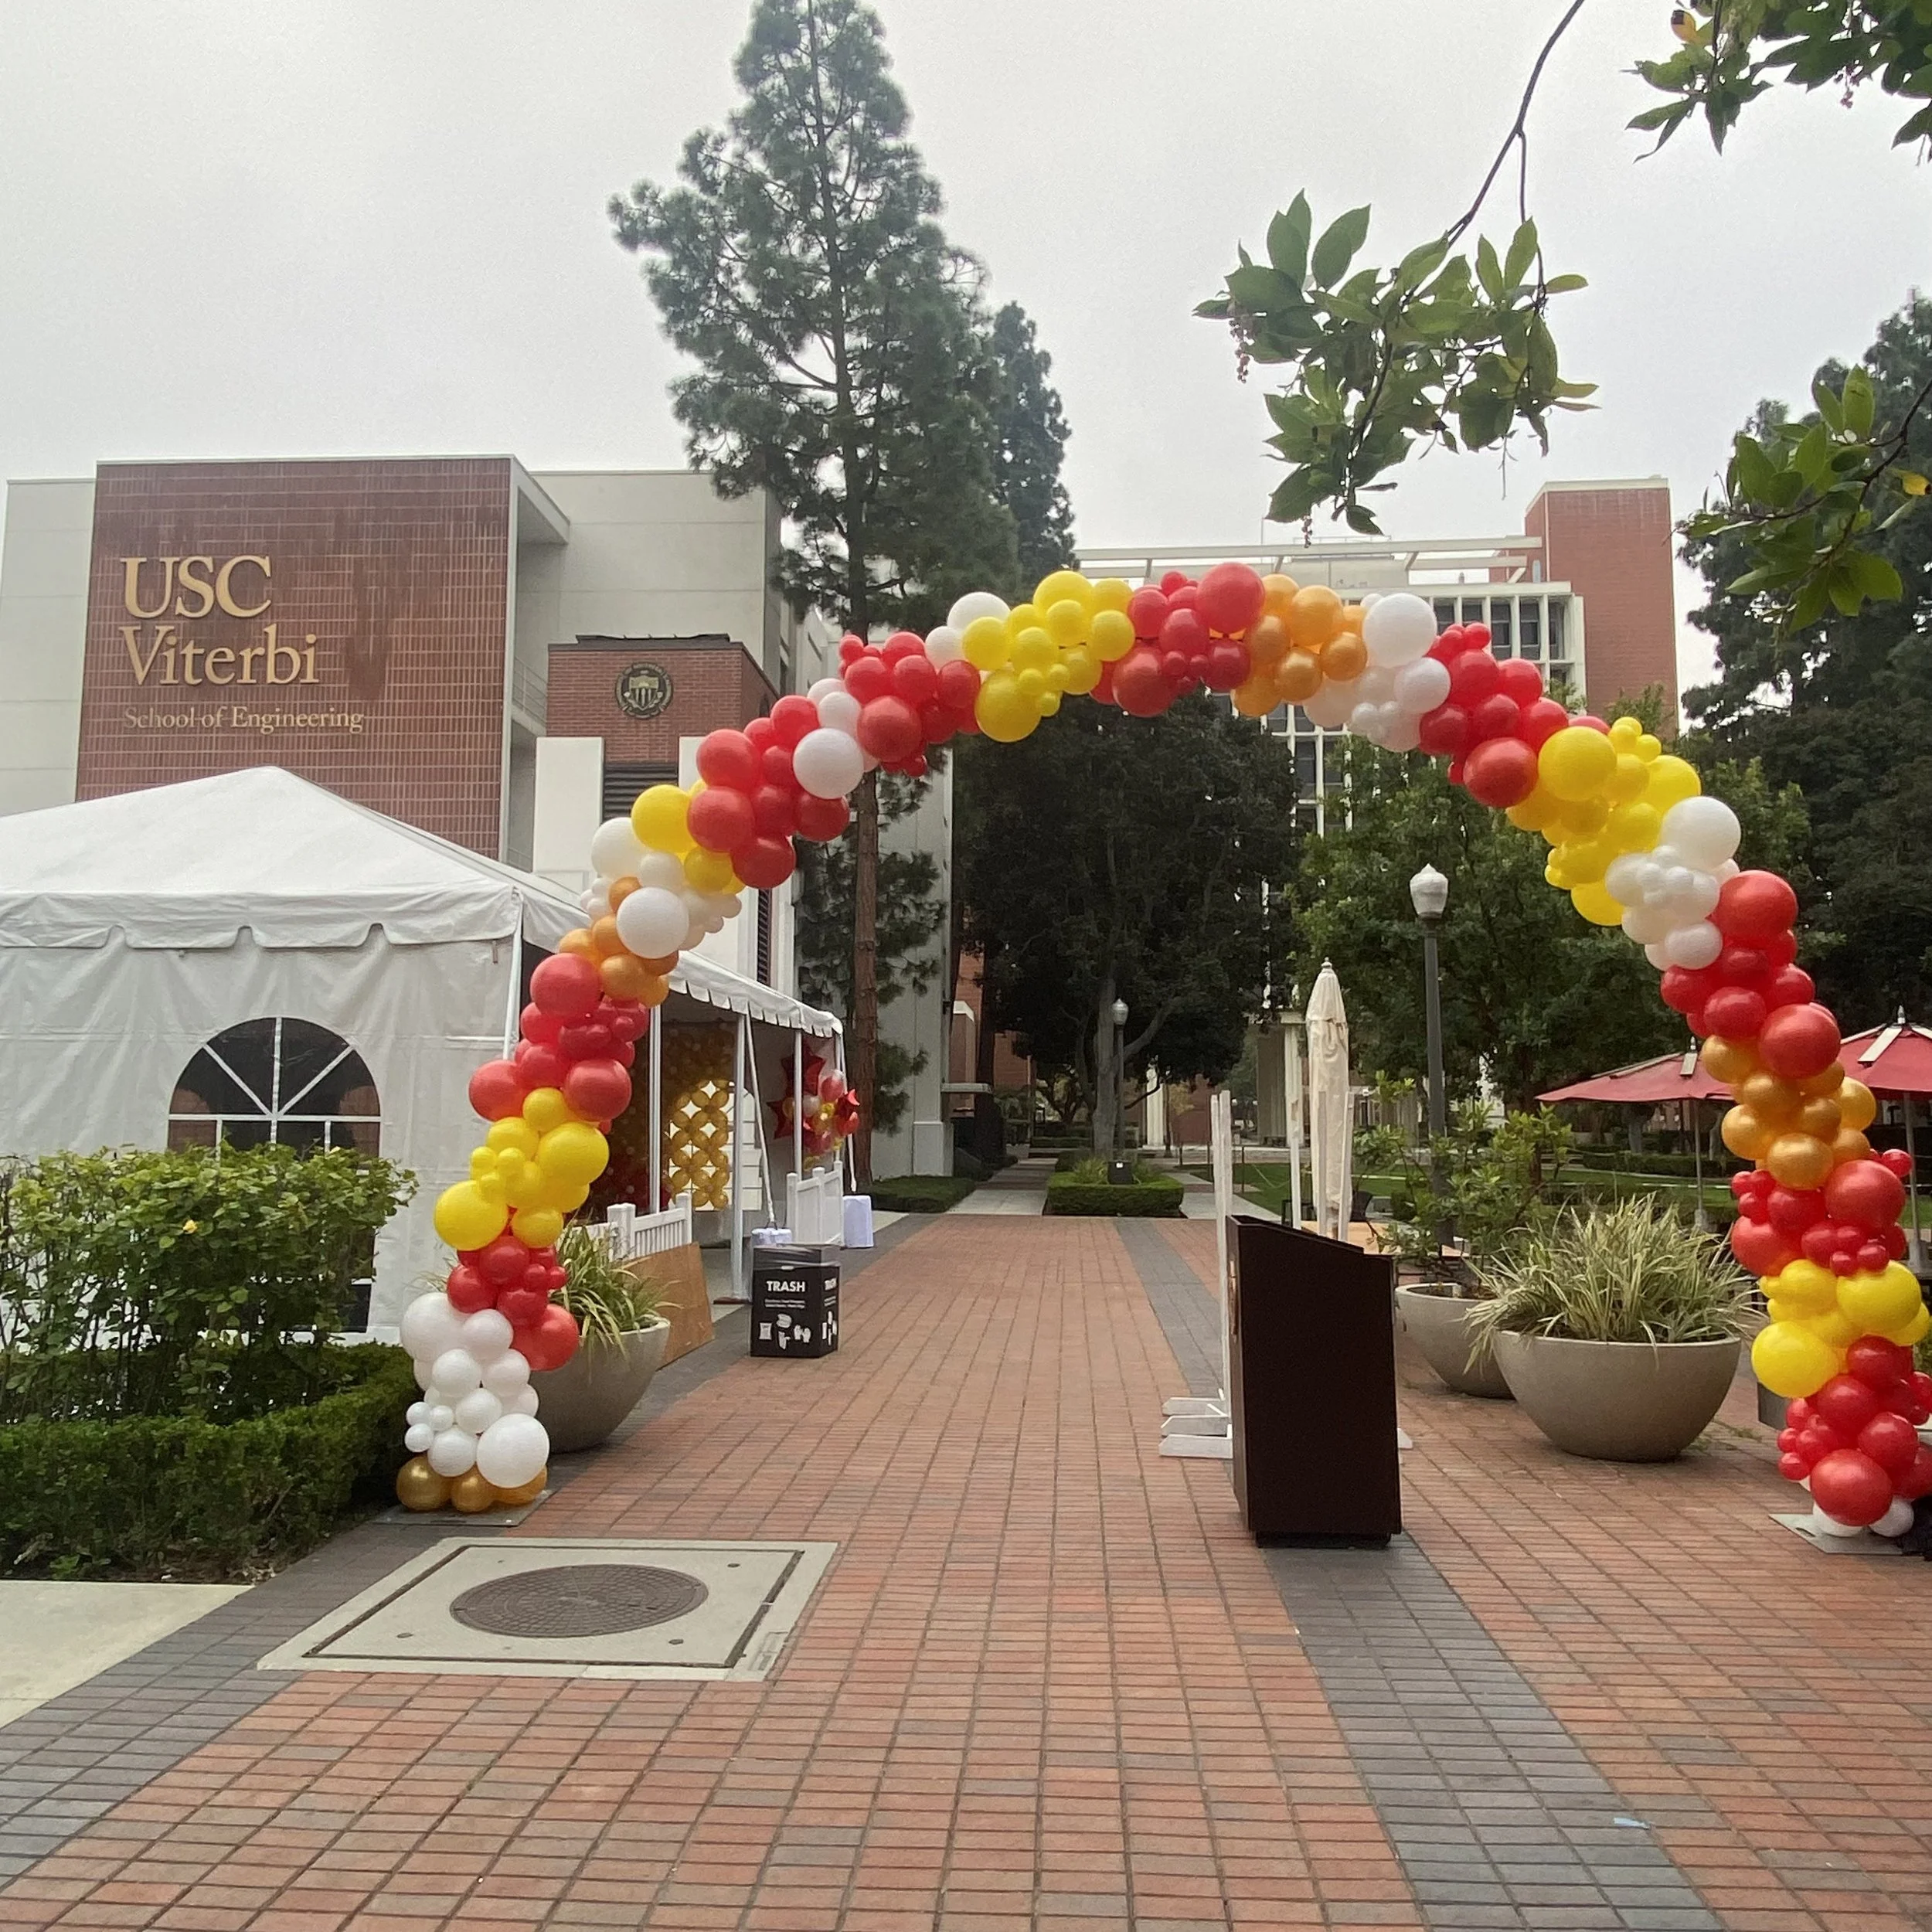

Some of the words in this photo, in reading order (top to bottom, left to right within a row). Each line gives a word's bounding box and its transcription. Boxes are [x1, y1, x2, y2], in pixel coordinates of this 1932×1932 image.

[120, 555, 271, 618] USC
[118, 623, 319, 685] Viterbi
[124, 706, 195, 729] School
[201, 706, 228, 728] of
[231, 706, 365, 734] Engineering
[766, 1281, 806, 1292] TRASH
